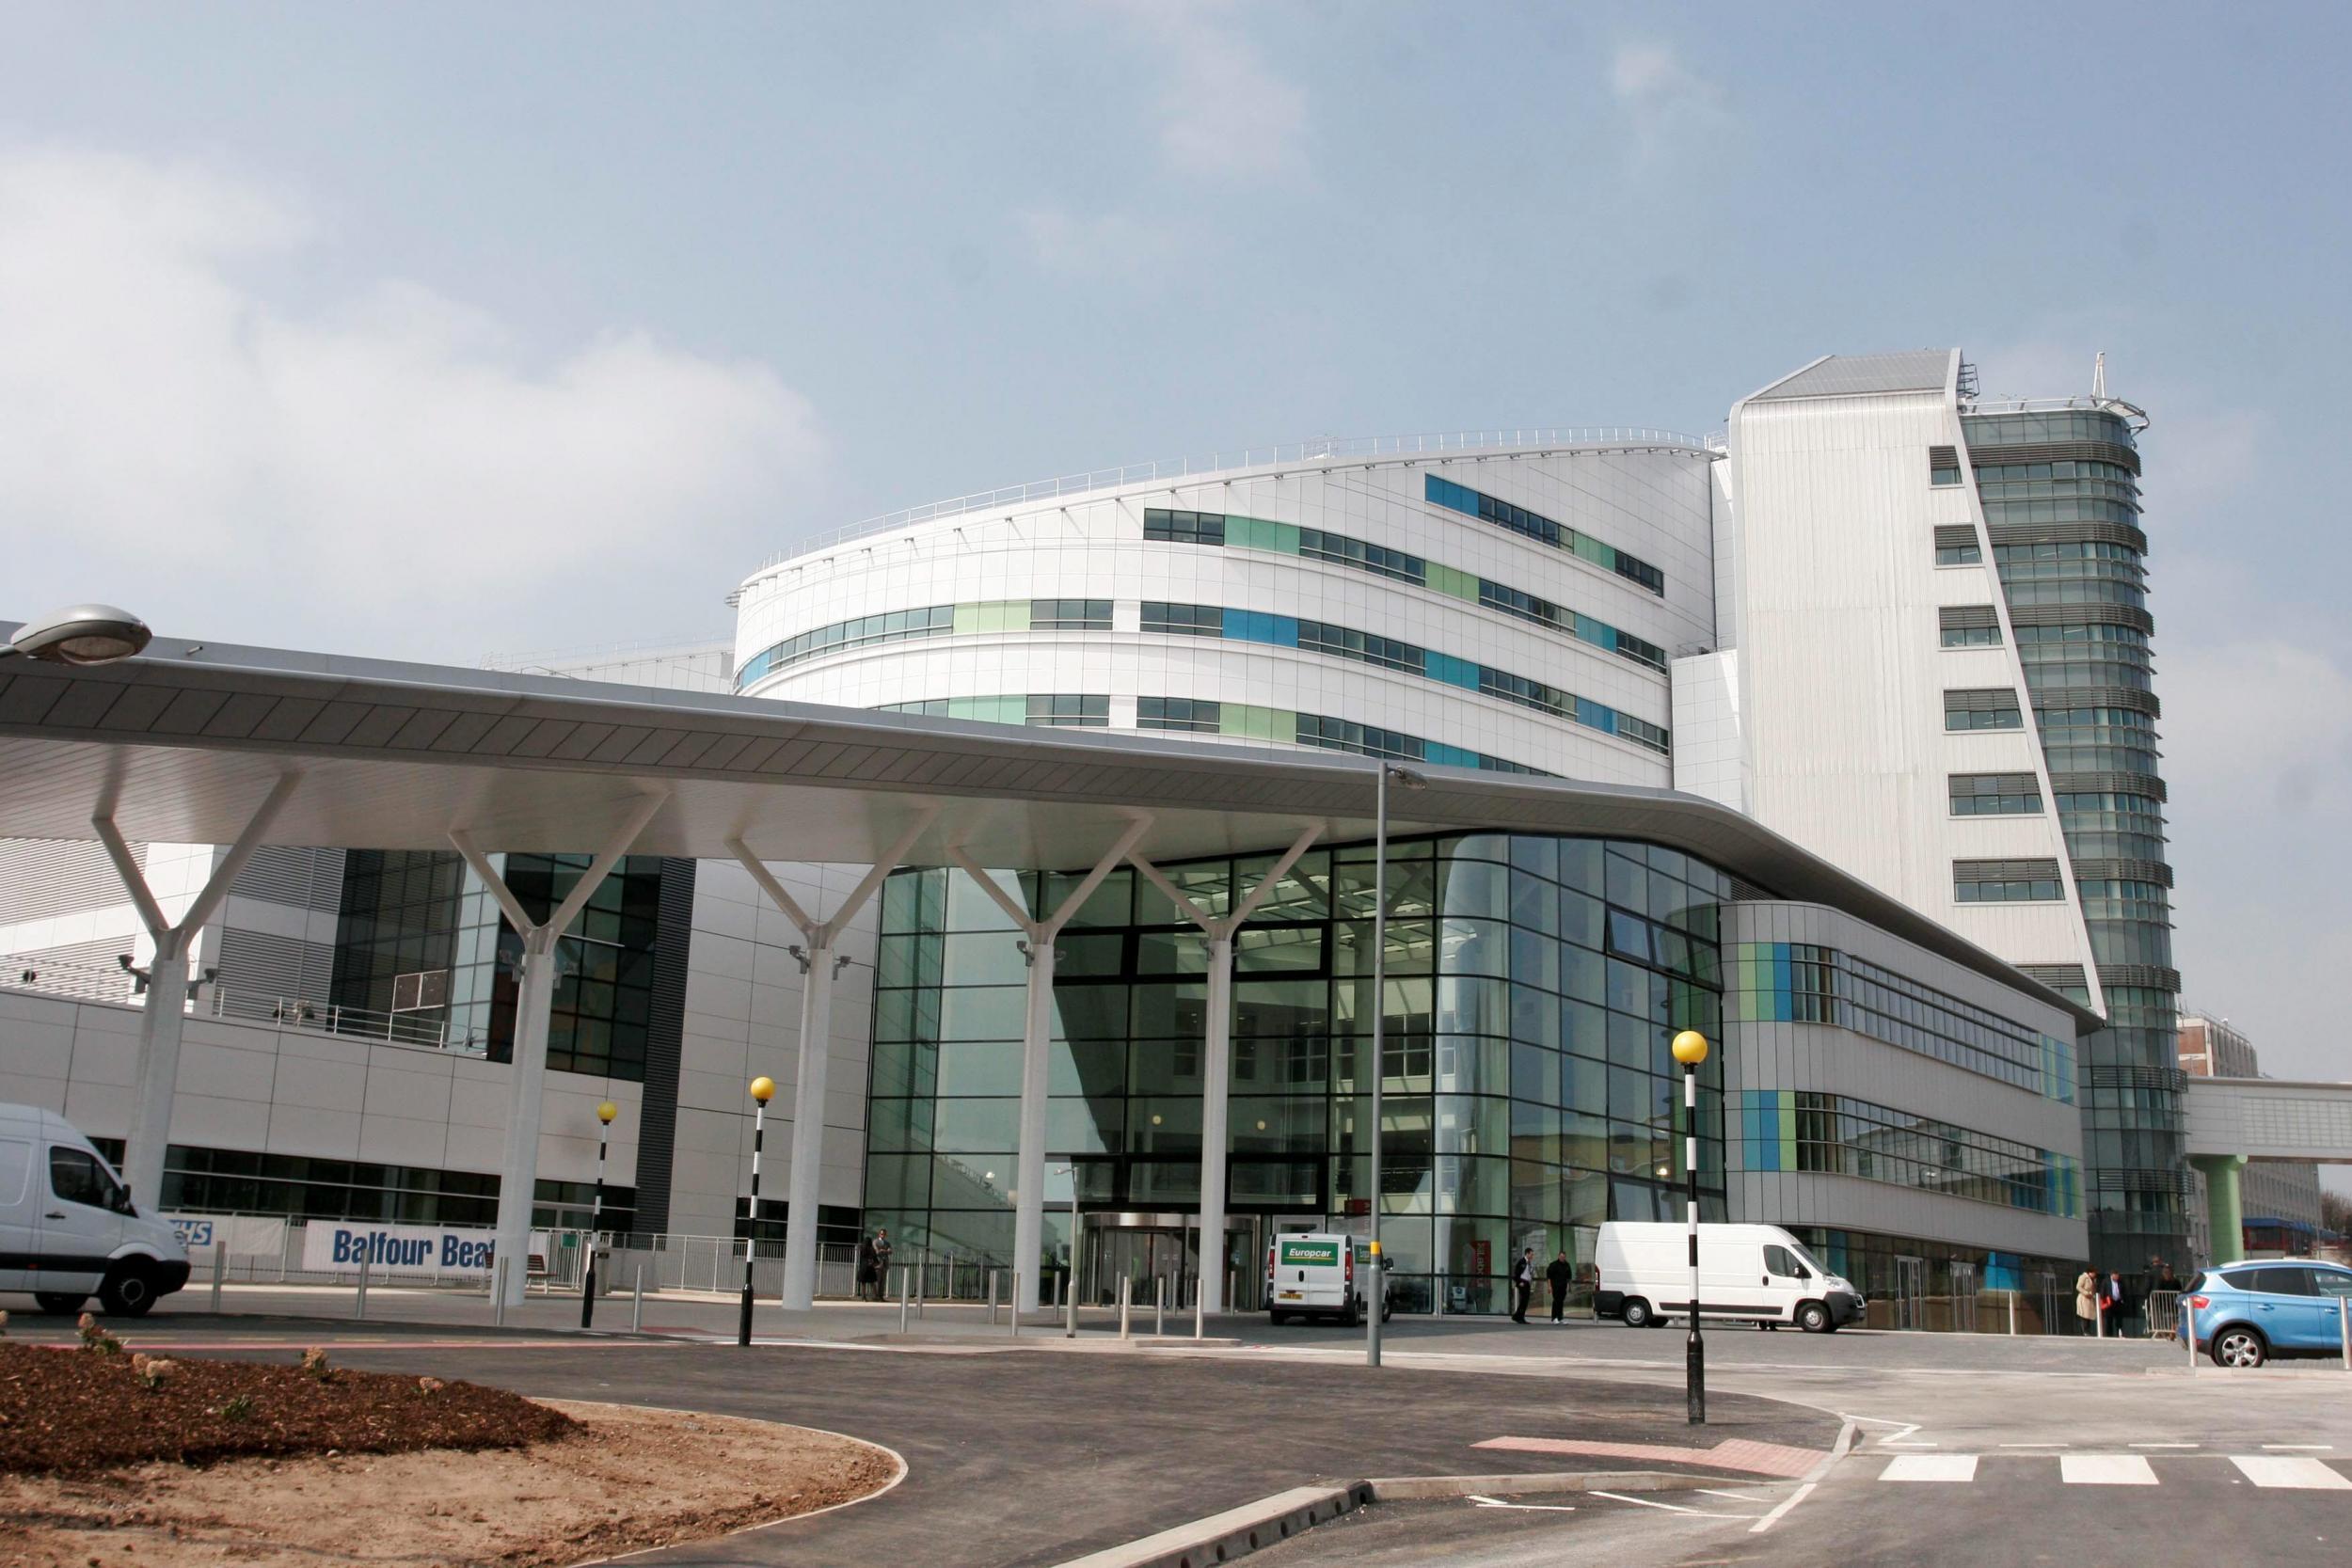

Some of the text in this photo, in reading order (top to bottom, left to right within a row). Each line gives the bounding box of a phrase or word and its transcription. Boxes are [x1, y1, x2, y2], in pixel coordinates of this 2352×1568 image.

[174, 1222, 211, 1243] HS
[333, 1230, 433, 1265] Balfour
[1289, 1248, 1332, 1258] Europcar
